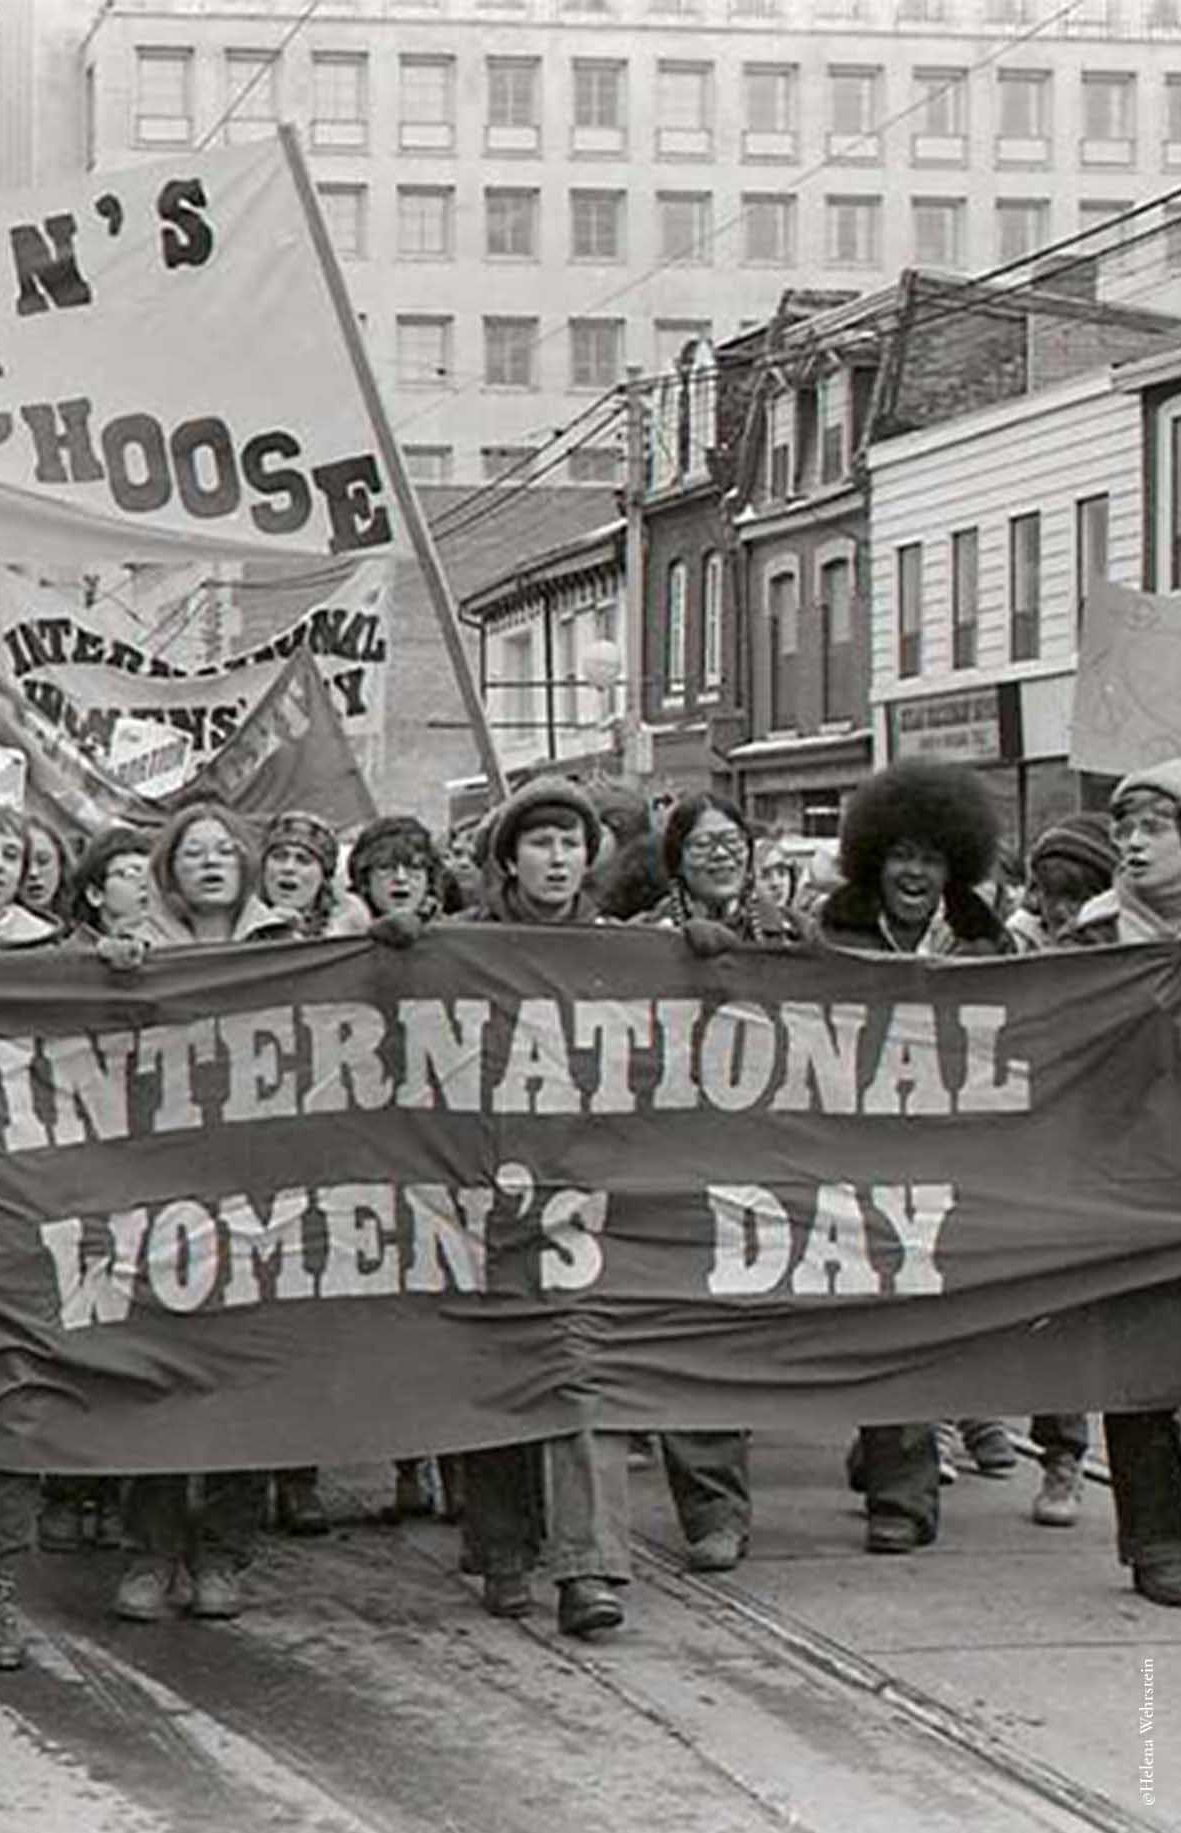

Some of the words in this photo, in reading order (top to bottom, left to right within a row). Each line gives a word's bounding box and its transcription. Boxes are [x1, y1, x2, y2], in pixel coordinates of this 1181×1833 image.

[3, 609, 386, 678] INTERONAL
[40, 1161, 609, 1332] WOMEN'S
[707, 1182, 957, 1297] DAY
